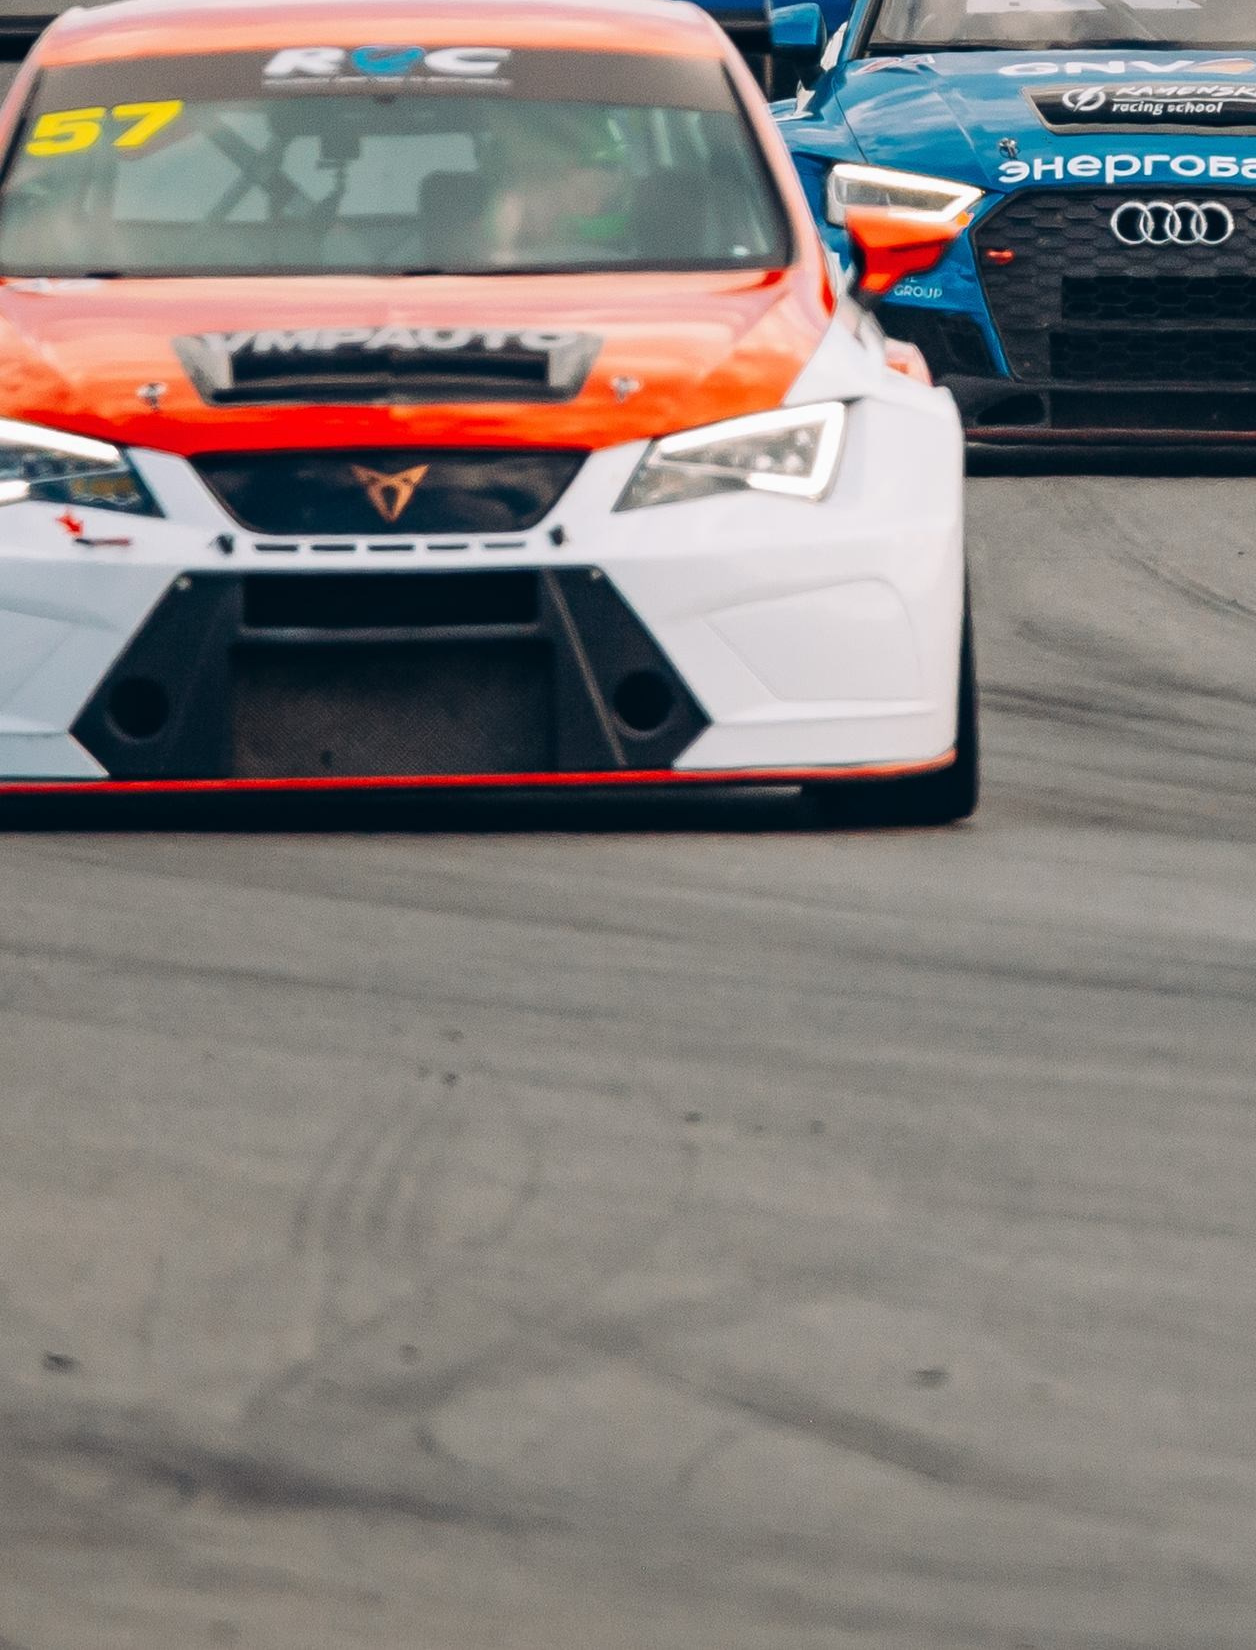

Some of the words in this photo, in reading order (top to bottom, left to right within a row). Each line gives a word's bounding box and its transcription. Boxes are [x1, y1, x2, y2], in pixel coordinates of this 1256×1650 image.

[998, 60, 1196, 77] GNV
[1111, 102, 1163, 116] racing
[1167, 102, 1223, 114] school
[27, 100, 184, 156] 57
[893, 284, 943, 299] GROUP
